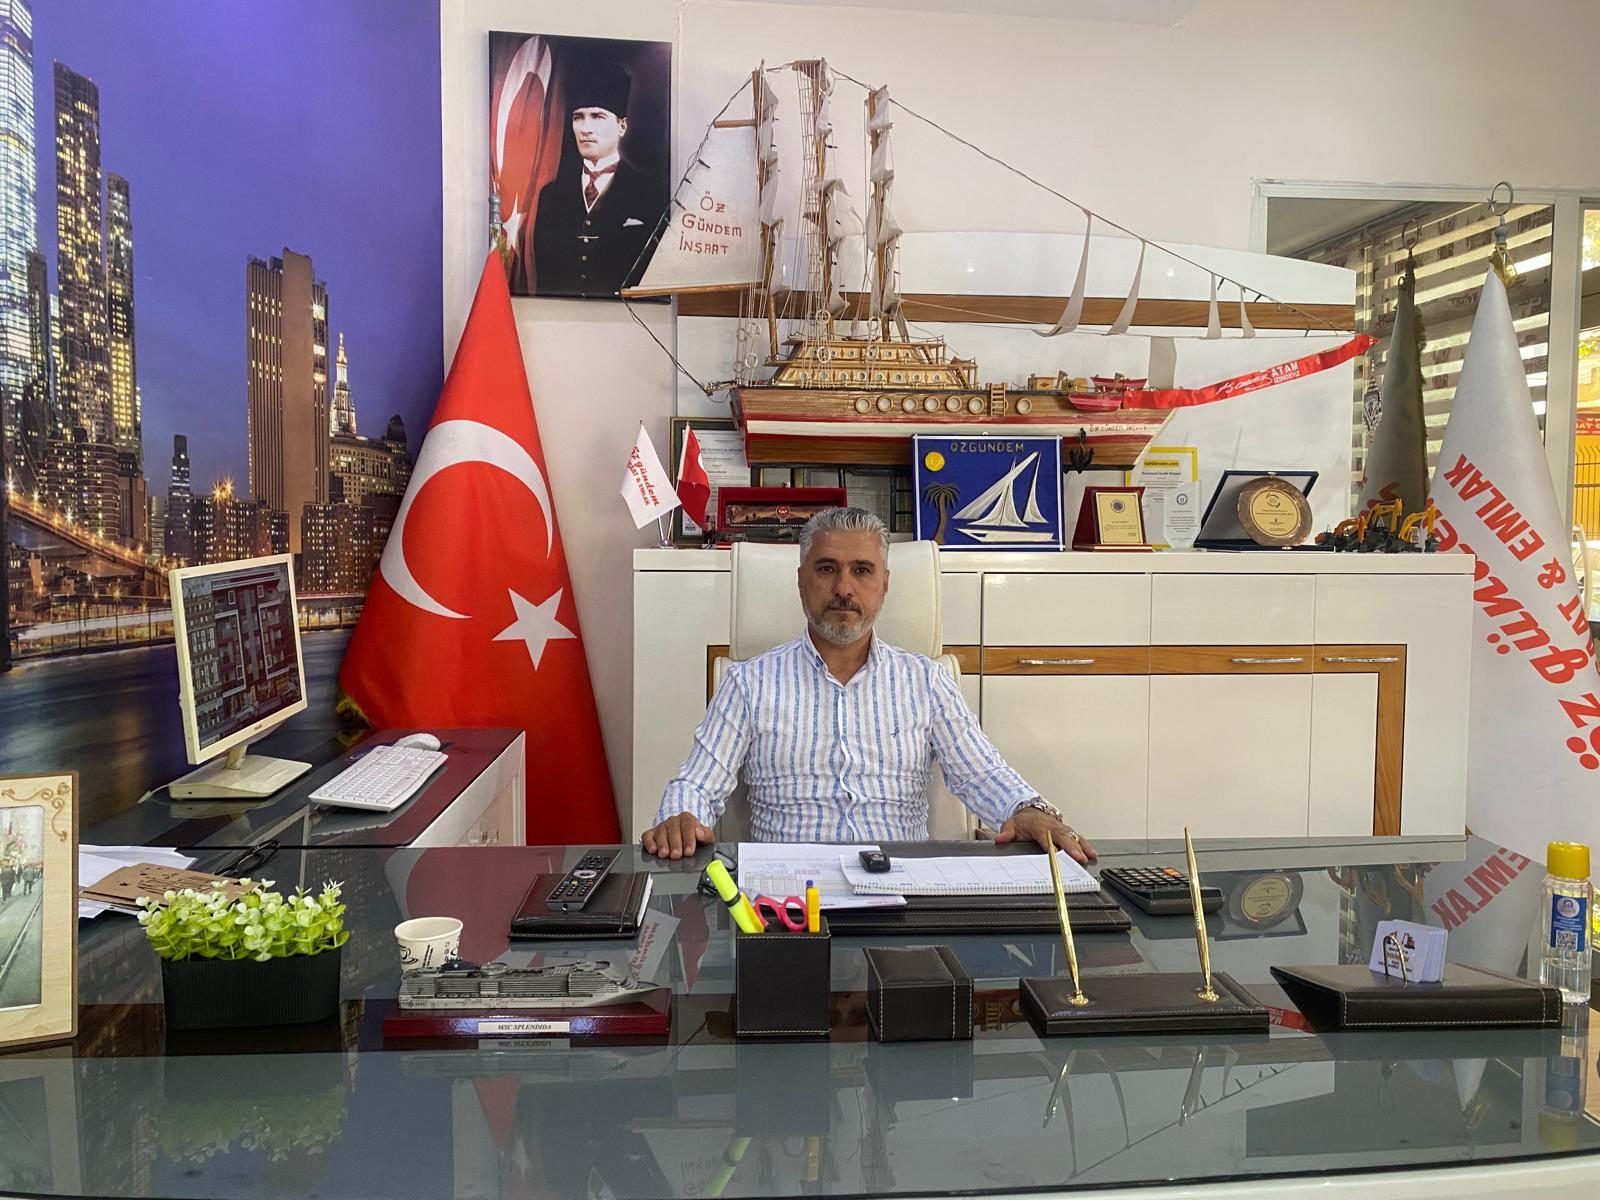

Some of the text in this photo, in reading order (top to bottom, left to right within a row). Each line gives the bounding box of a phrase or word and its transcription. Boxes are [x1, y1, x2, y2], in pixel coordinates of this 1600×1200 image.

[1271, 361, 1299, 378] ATAM
[633, 461, 660, 507] gündem
[1443, 453, 1545, 562] EMLAK
[1537, 557, 1567, 590] &
[497, 1023, 552, 1031] MSC SPLENDIDA
